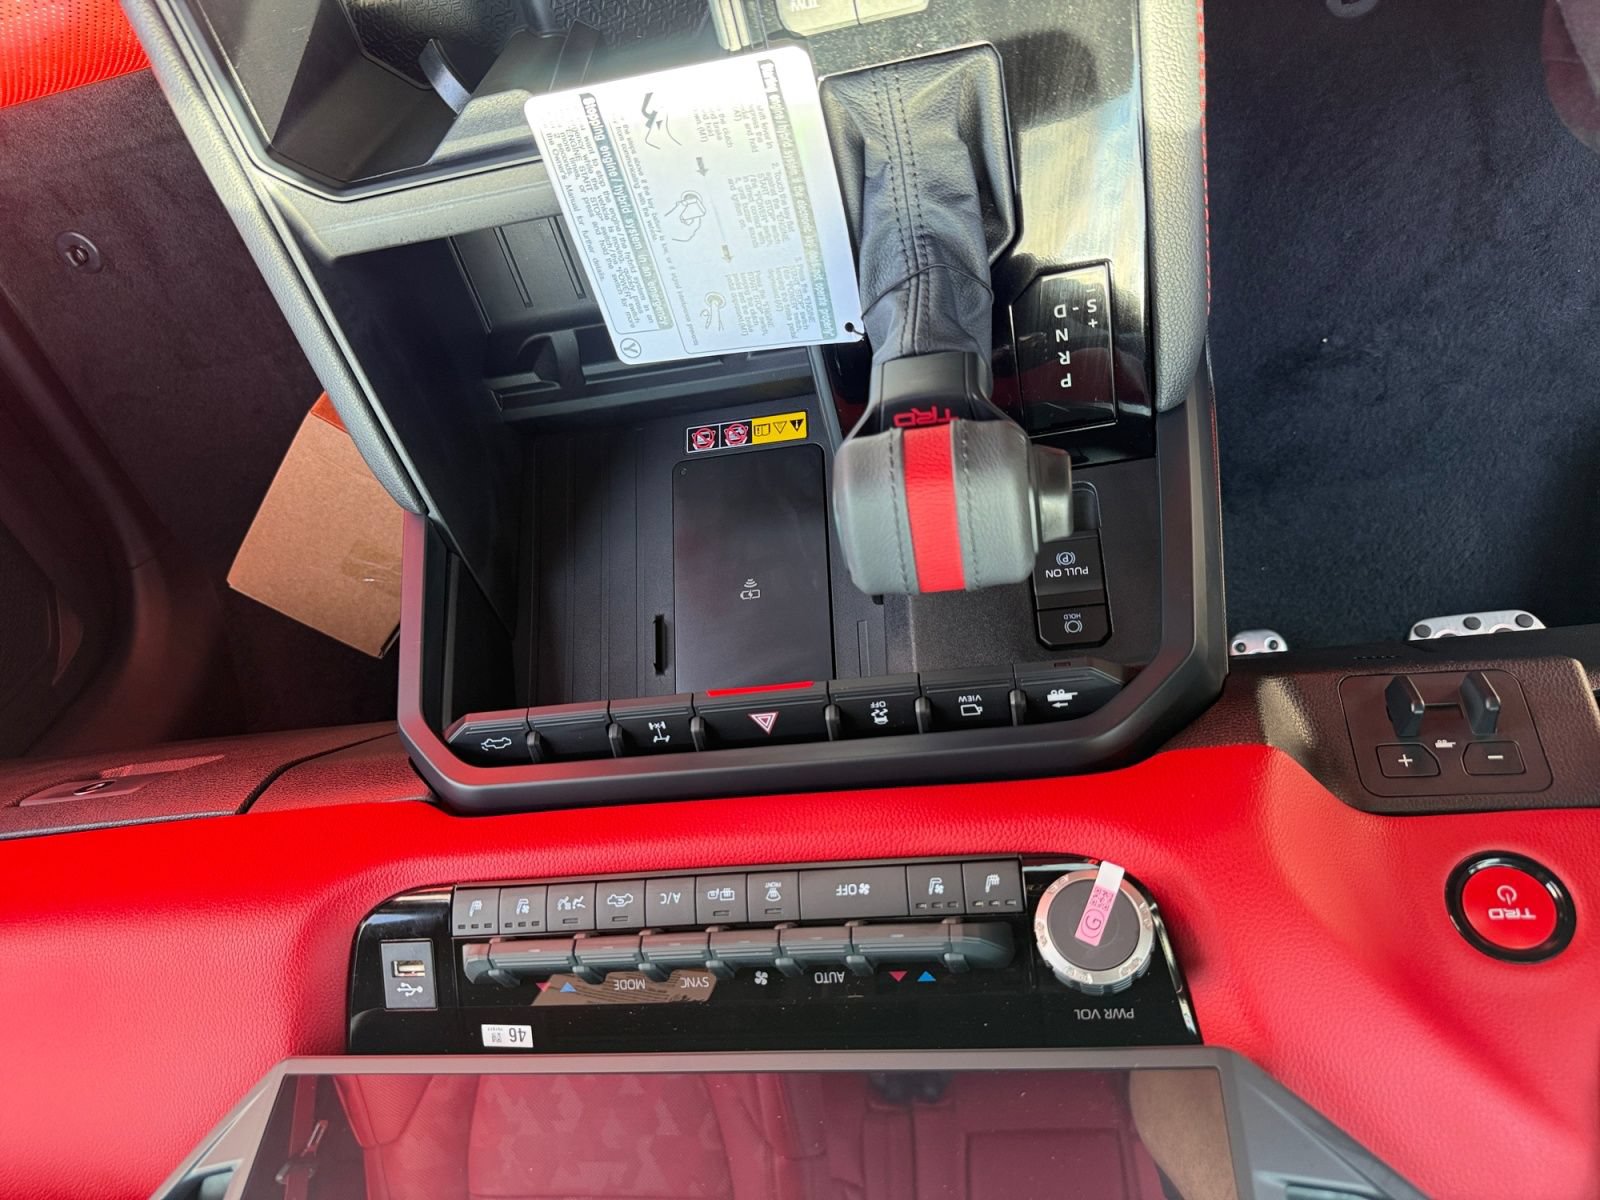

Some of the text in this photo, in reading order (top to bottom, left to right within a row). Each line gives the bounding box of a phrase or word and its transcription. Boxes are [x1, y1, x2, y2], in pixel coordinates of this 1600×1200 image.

[581, 96, 607, 141] Stopping
[564, 184, 580, 211] Manual
[623, 218, 643, 250] system
[637, 254, 649, 262] in
[641, 266, 651, 276] an
[813, 282, 828, 306] operate
[644, 280, 668, 325] emergency
[1086, 299, 1097, 313] S
[1053, 304, 1067, 318] D
[1055, 328, 1068, 343] N
[1058, 351, 1071, 365] R
[1060, 373, 1072, 388] P
[893, 405, 959, 427] TRD
[1045, 566, 1089, 578] PULL ON
[870, 701, 886, 709] OFF
[958, 694, 982, 703] VIEW
[835, 884, 857, 896] OFF
[660, 892, 681, 905] A/C
[1488, 907, 1537, 920] TRD
[680, 976, 709, 989] SYNC
[814, 971, 845, 984] AUTO
[613, 979, 646, 991] MODE
[1073, 1008, 1135, 1020] PWR VOL
[508, 1027, 526, 1042] 46
